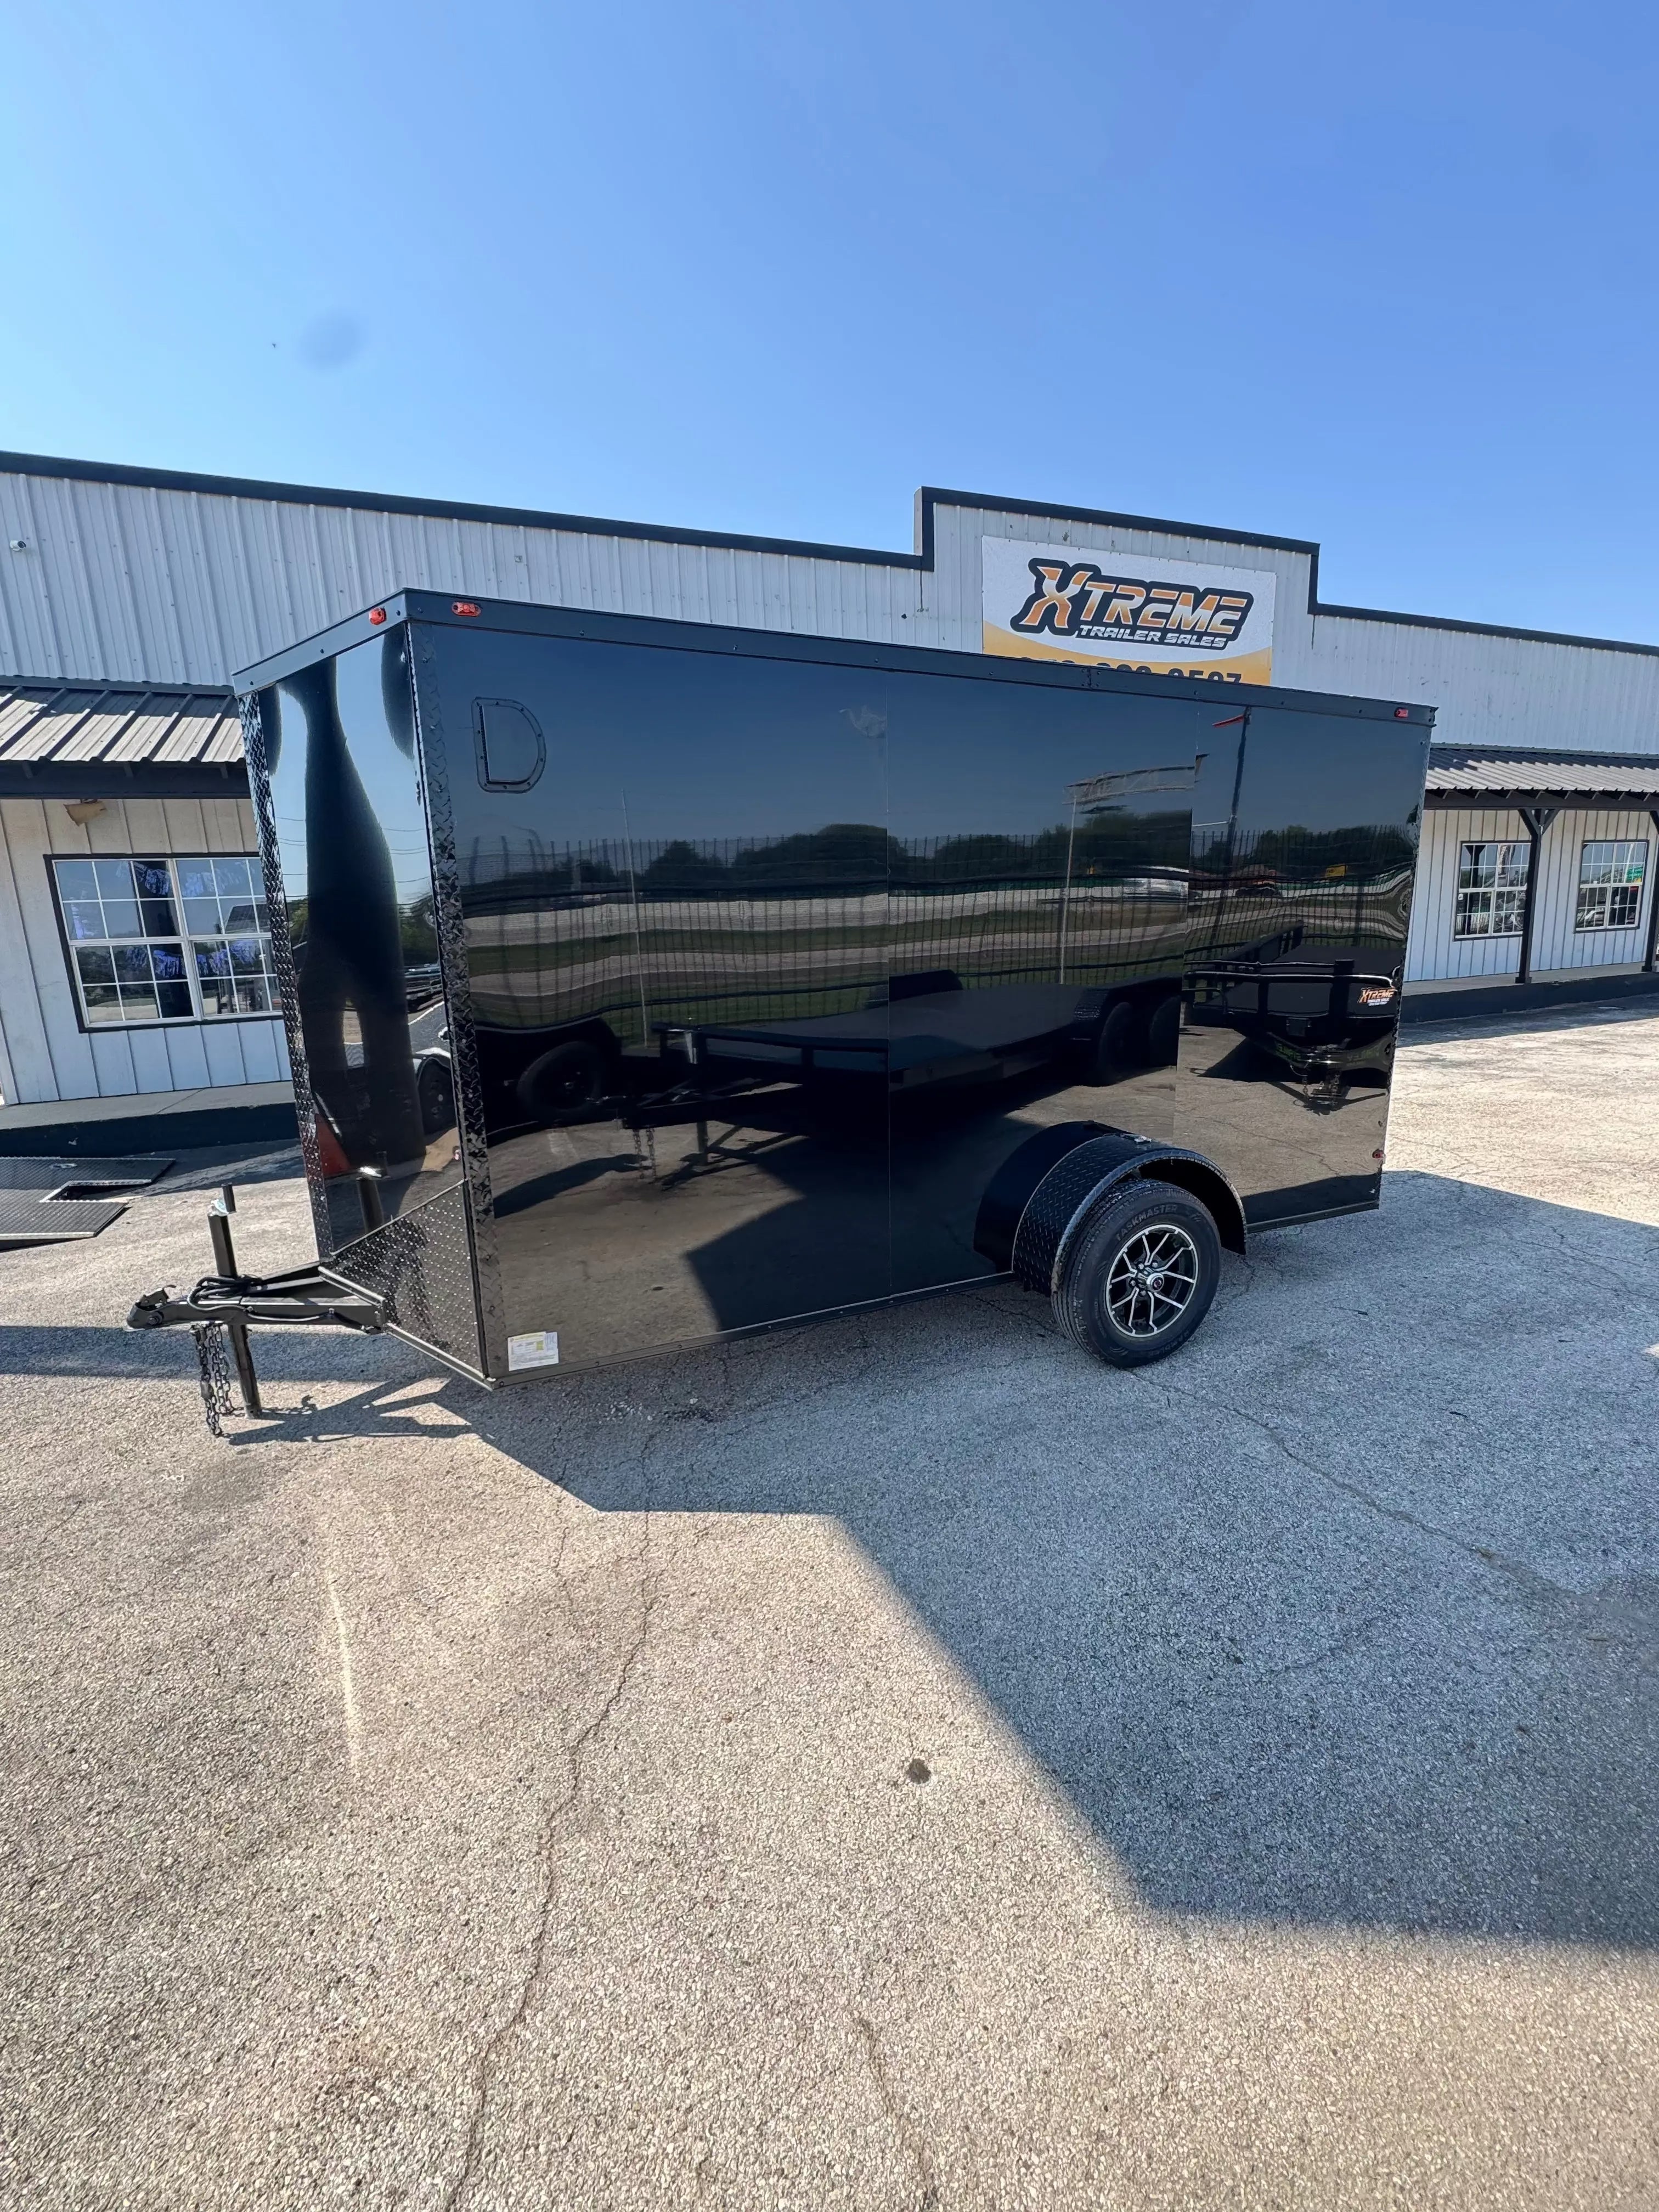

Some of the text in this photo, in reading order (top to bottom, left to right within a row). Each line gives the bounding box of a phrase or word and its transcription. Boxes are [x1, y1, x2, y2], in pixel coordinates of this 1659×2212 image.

[1019, 566, 1248, 635] XTREME
[1079, 624, 1227, 647] TRAILER SALES
[1358, 988, 1395, 1003] XTREME
